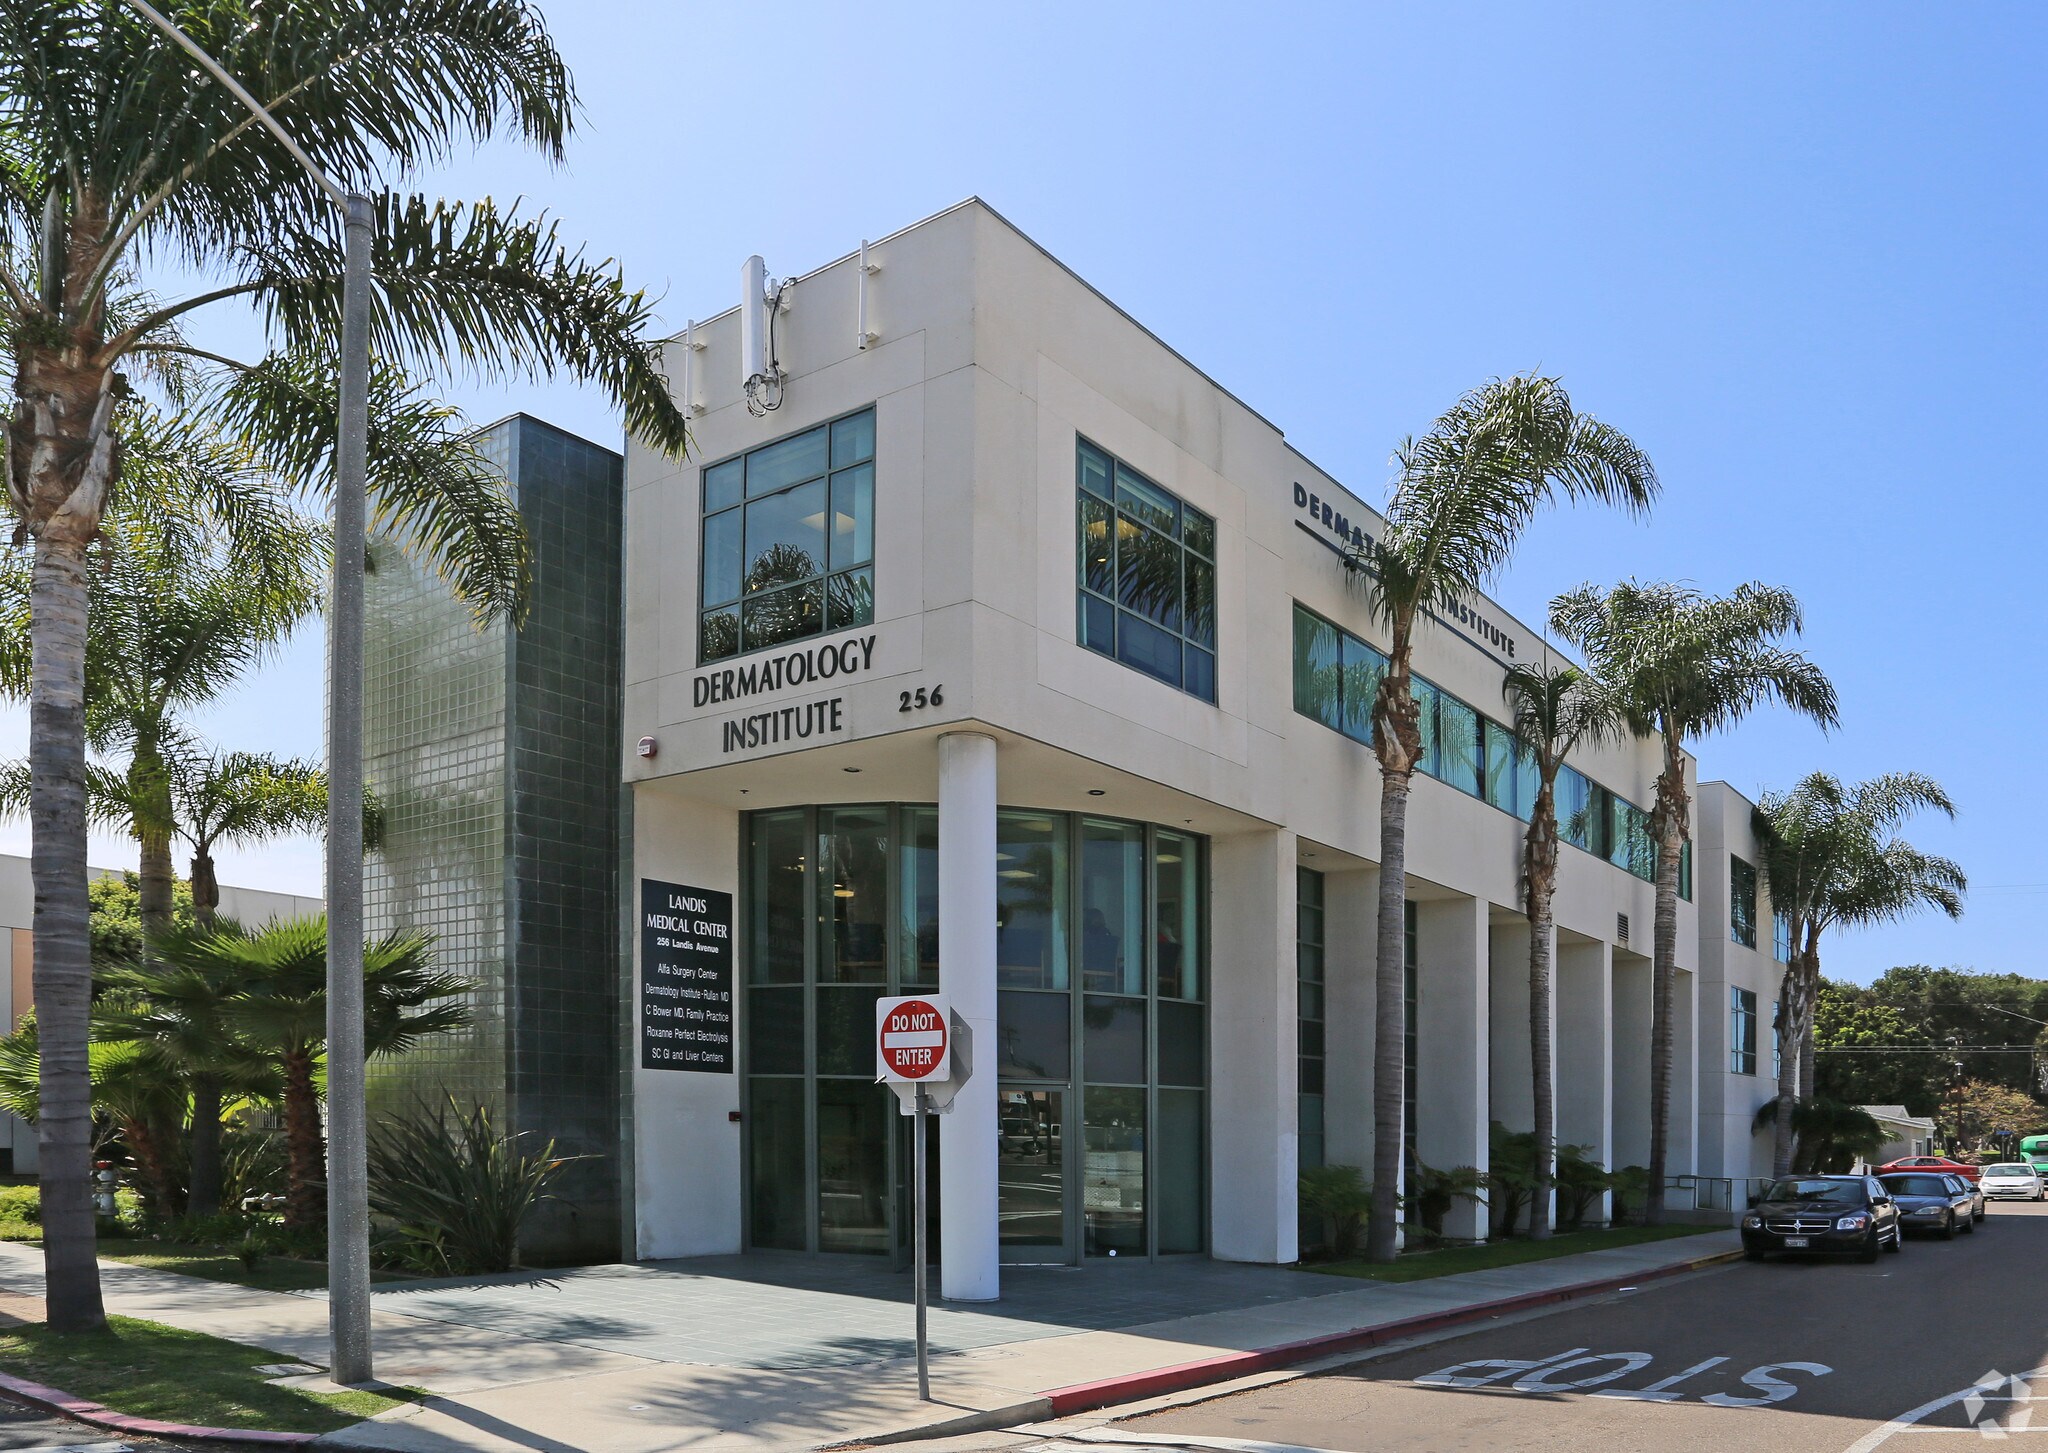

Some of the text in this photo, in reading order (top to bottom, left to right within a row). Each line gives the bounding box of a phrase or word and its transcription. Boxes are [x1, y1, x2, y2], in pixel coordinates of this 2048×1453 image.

[693, 634, 877, 708] DERMATOLOGY
[899, 683, 945, 712] 256
[722, 697, 842, 753] INSTITUTE
[669, 894, 707, 914] LANDIS
[646, 913, 728, 939] MEDICAL CENTER
[656, 936, 719, 954] 256 Landis Avenue
[657, 963, 718, 980] Alfa Surgery Center
[645, 983, 680, 999] Dermatology
[720, 991, 729, 1002] MD
[645, 1004, 729, 1023] C Bower MD, Family Practice
[892, 1013, 936, 1031] DO NOT
[646, 1026, 729, 1044] Roxanne Perfect Electrolysis
[651, 1047, 662, 1059] SC
[672, 1050, 683, 1060] and
[685, 1050, 700, 1061] Liver
[701, 1051, 724, 1063] Centers
[895, 1048, 932, 1066] ENTER
[1413, 1347, 1835, 1408] STOP
